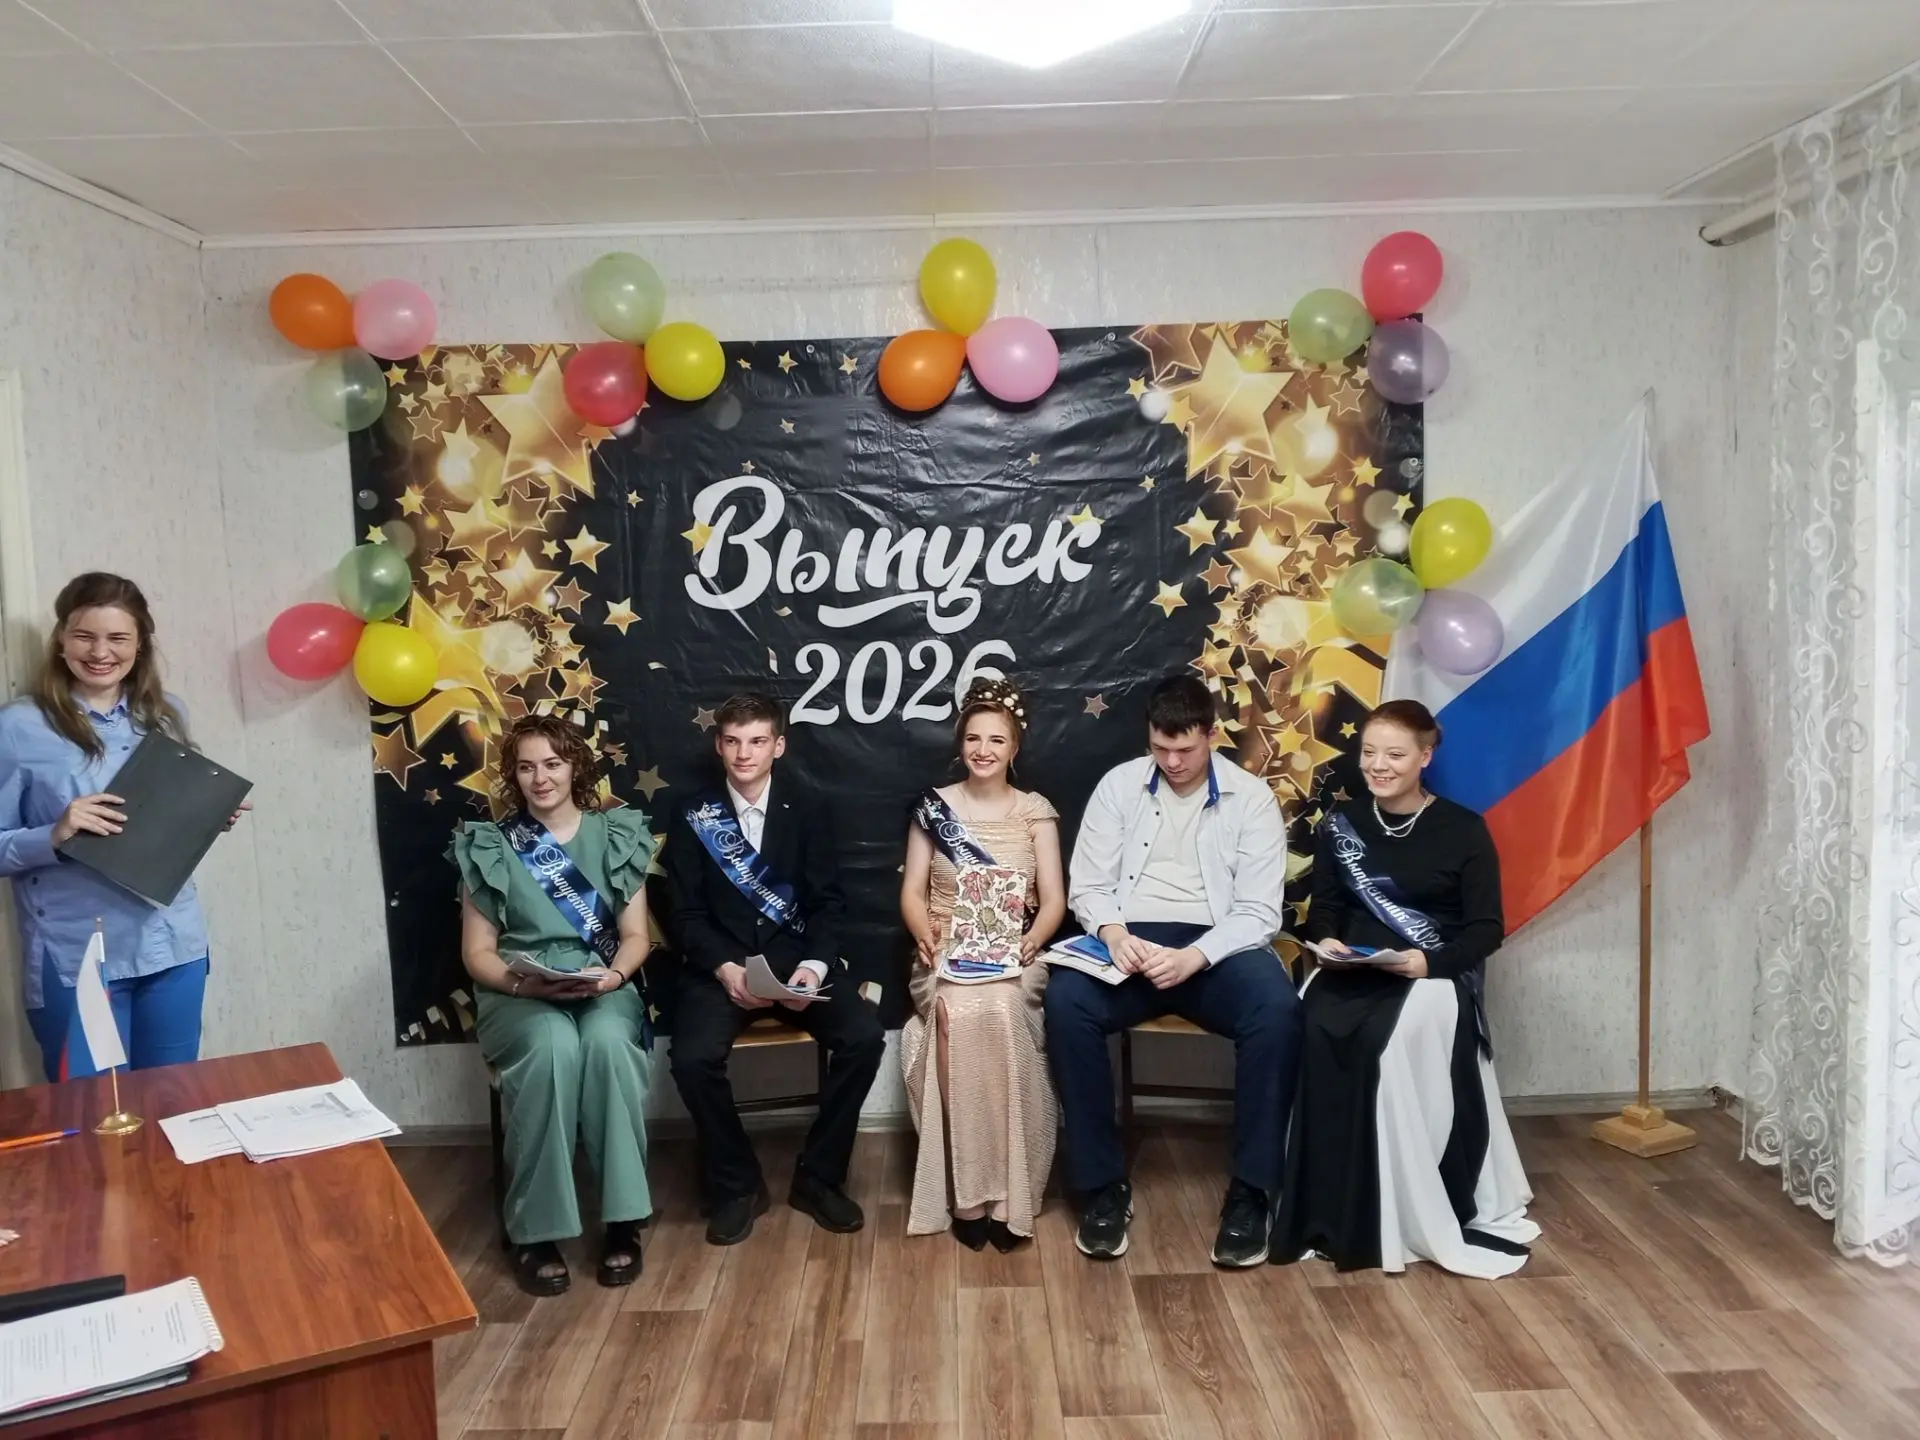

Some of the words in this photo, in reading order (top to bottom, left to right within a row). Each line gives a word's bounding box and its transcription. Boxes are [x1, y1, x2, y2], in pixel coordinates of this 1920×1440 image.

[684, 475, 1101, 634] Выпуск
[532, 844, 604, 933] Выпускница
[712, 828, 787, 910] Выпускник
[1334, 833, 1409, 923] Выпускник
